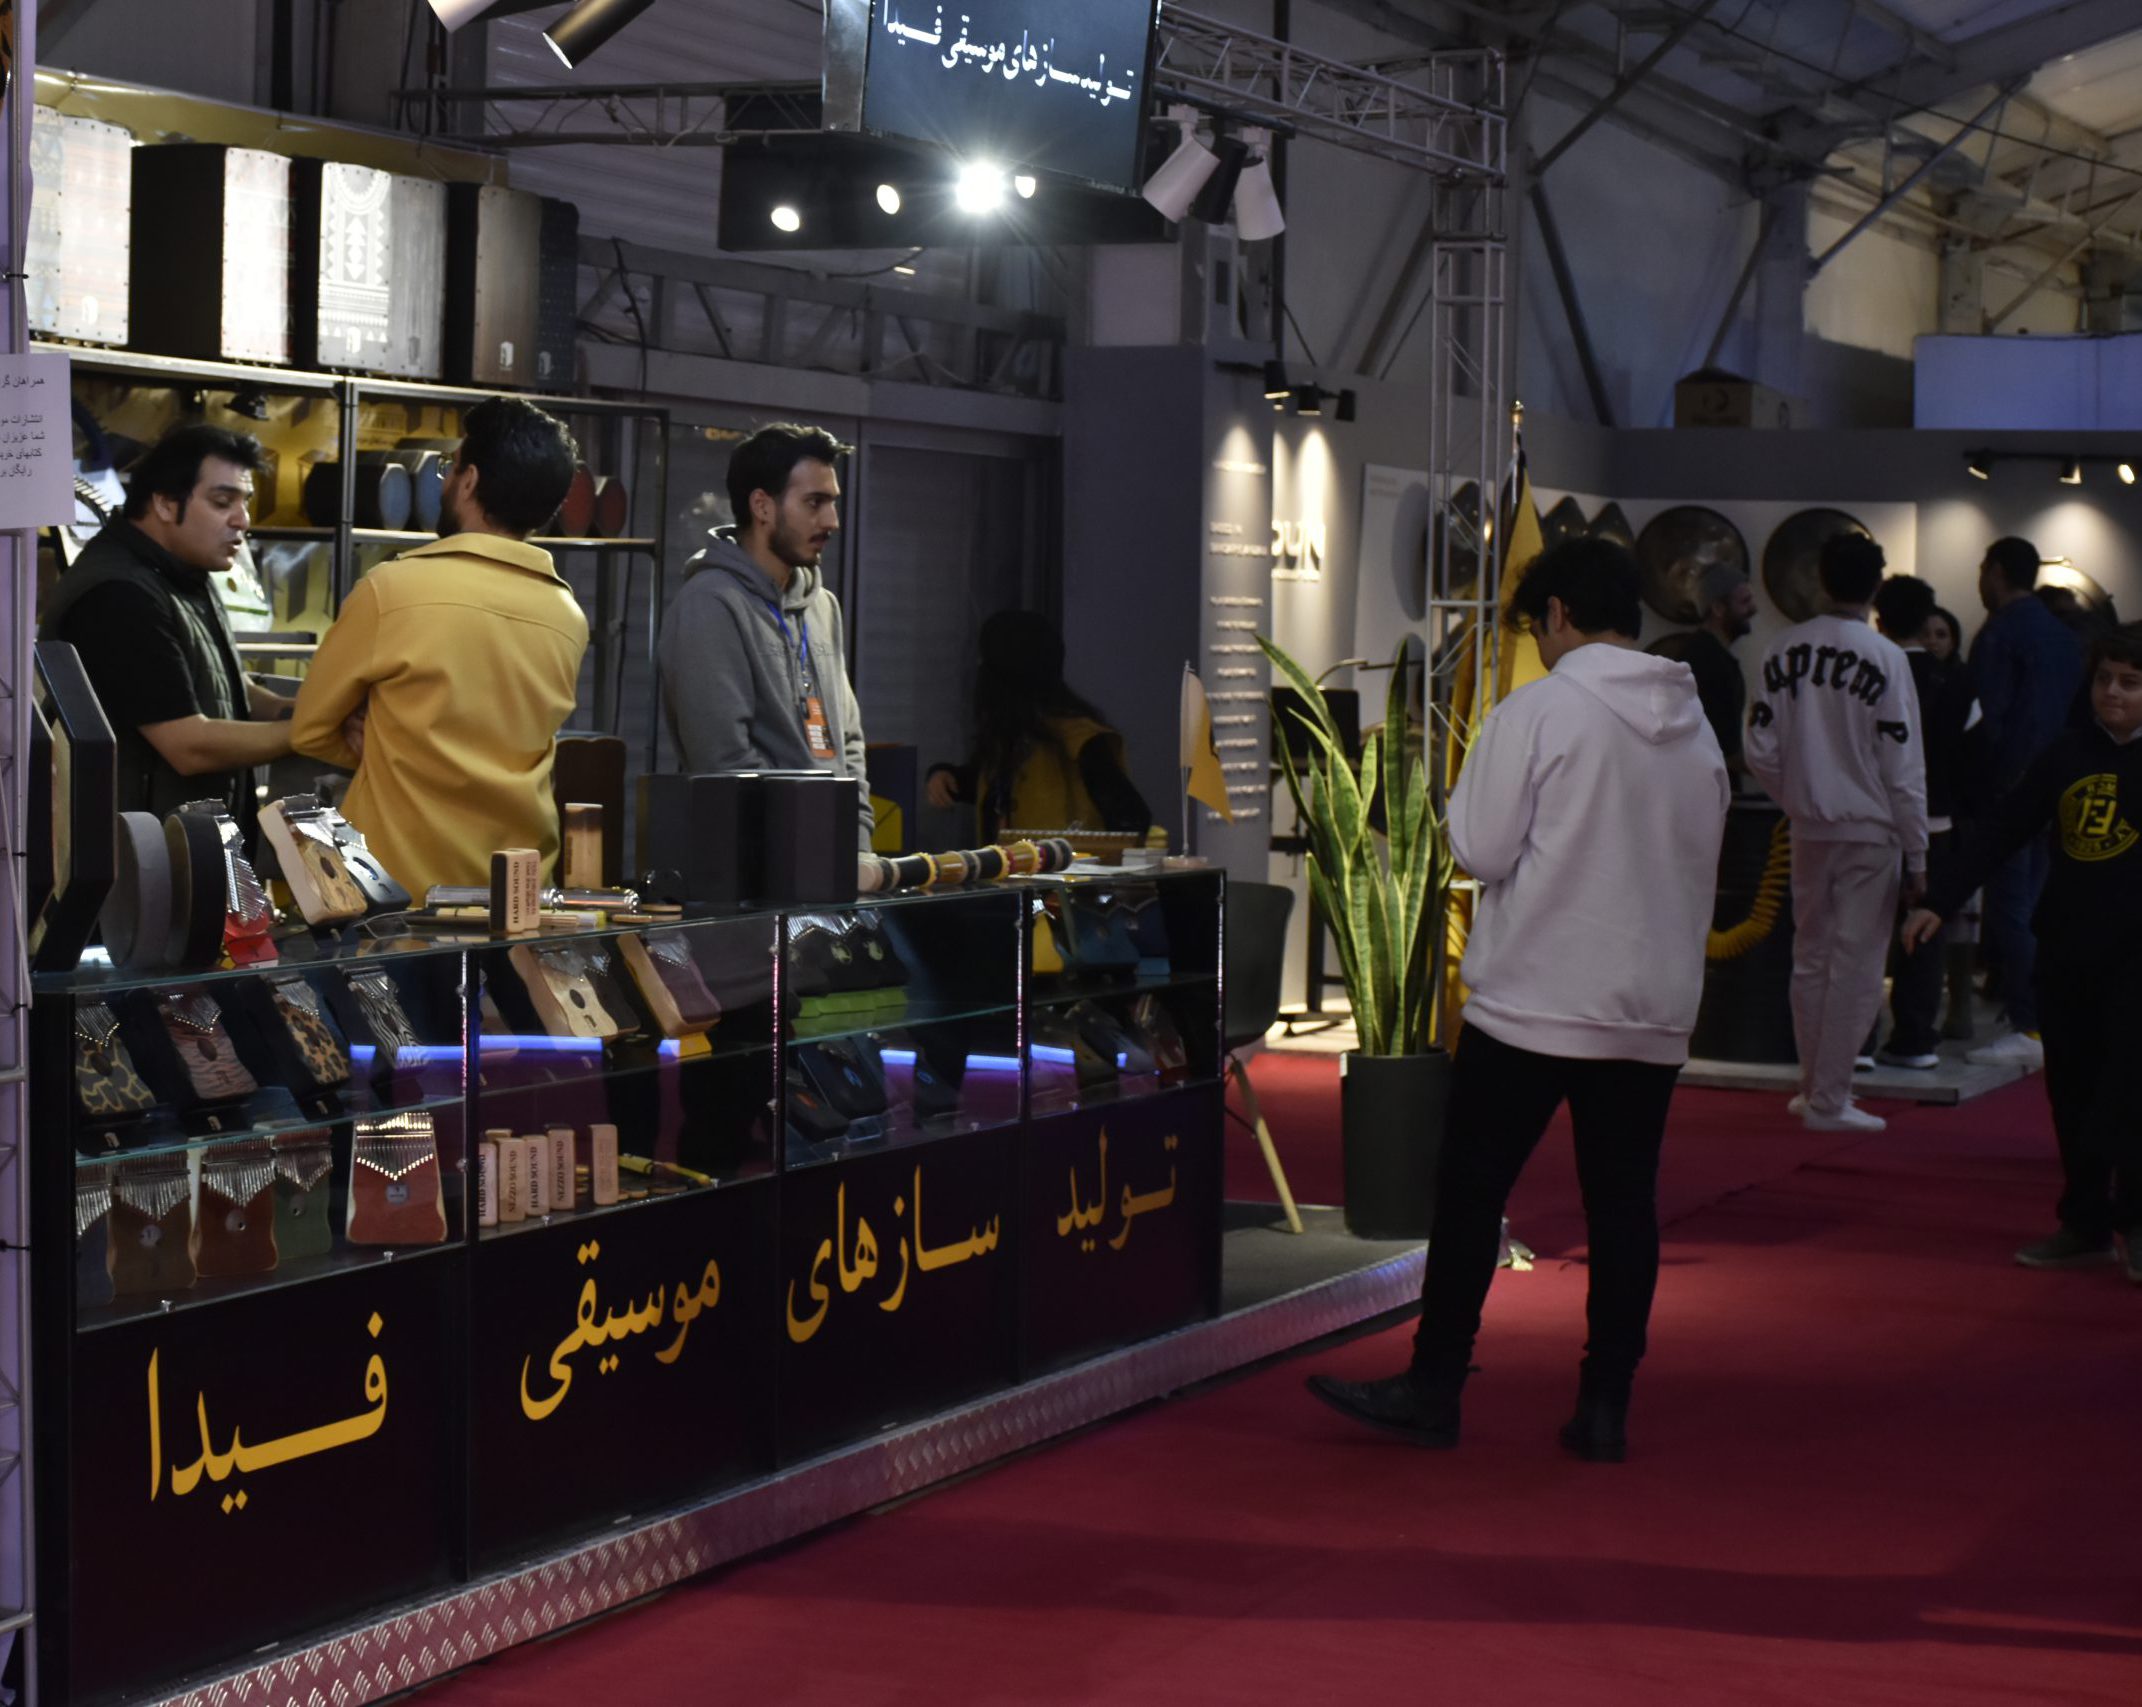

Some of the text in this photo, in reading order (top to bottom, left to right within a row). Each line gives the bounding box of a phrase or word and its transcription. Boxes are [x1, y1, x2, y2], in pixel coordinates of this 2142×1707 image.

[1003, 29, 1080, 86] سازهای
[530, 1180, 539, 1208] HARD
[148, 1125, 1178, 1515] تولید سازهای موسیقی فیدا
